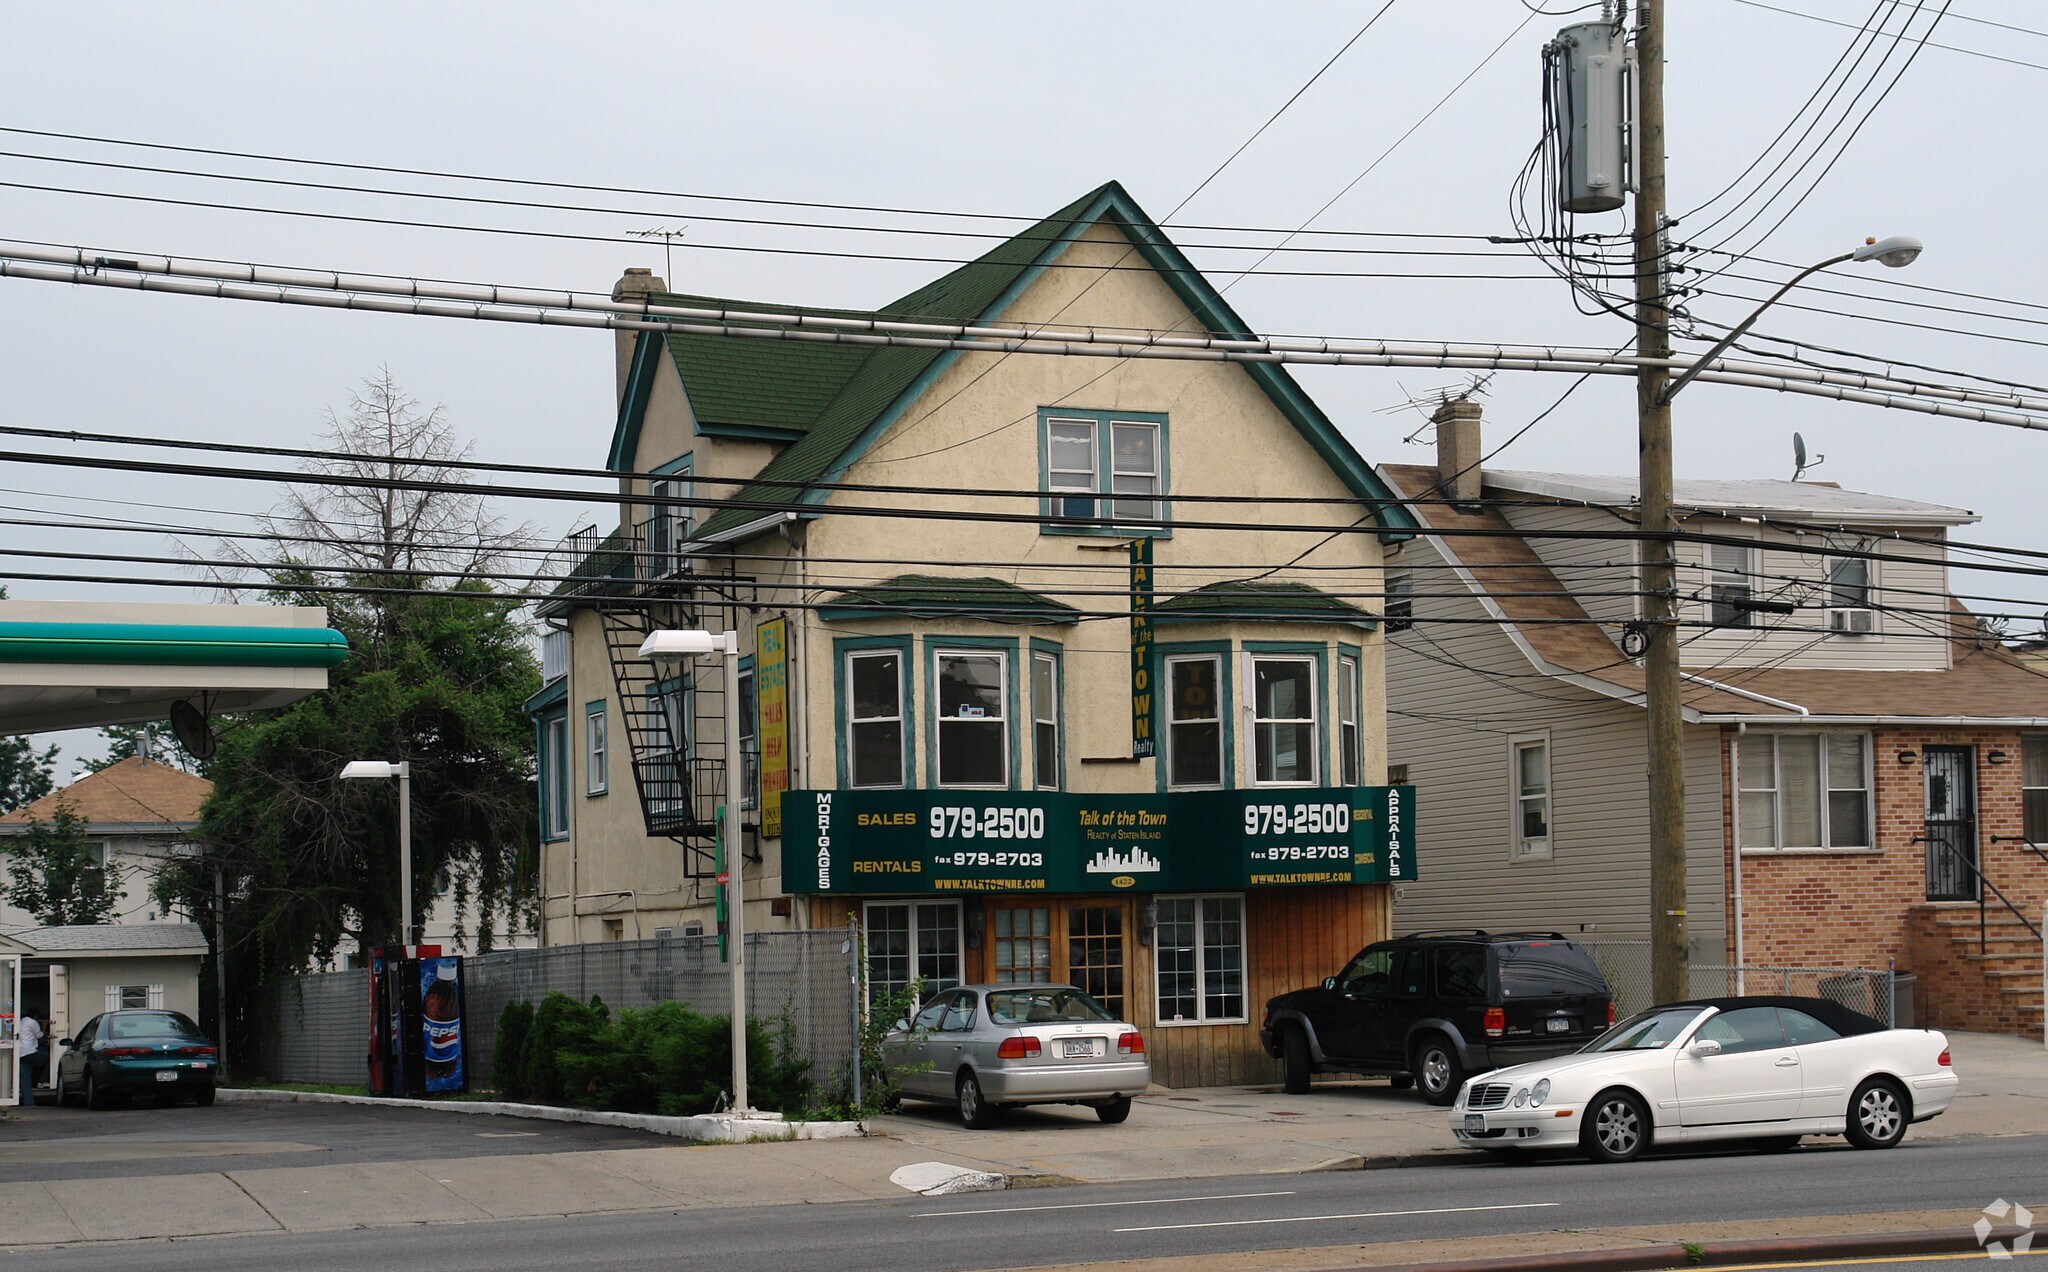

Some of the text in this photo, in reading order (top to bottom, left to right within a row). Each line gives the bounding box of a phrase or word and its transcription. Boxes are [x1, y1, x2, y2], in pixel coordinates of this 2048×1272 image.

[1140, 629, 1152, 643] the
[1133, 645, 1150, 739] TOWN
[1133, 739, 1153, 756] Realty
[857, 812, 917, 826] SALES
[930, 806, 1045, 839] 979-2500
[1080, 810, 1167, 826] Talk of the Town
[1244, 803, 1349, 835] 979-2500
[816, 793, 832, 889] MORTGAGES
[1388, 789, 1401, 877] APPRAISALS
[934, 852, 1043, 867] fax 979-2703
[1250, 845, 1350, 861] fax 979-2703
[853, 860, 922, 873] RENTALS
[934, 878, 1045, 891] WWW.TALKTOWNRE.COM
[1250, 872, 1352, 885] WWW.TALKTOWNRE.COM
[422, 1023, 460, 1037] PEPSI
